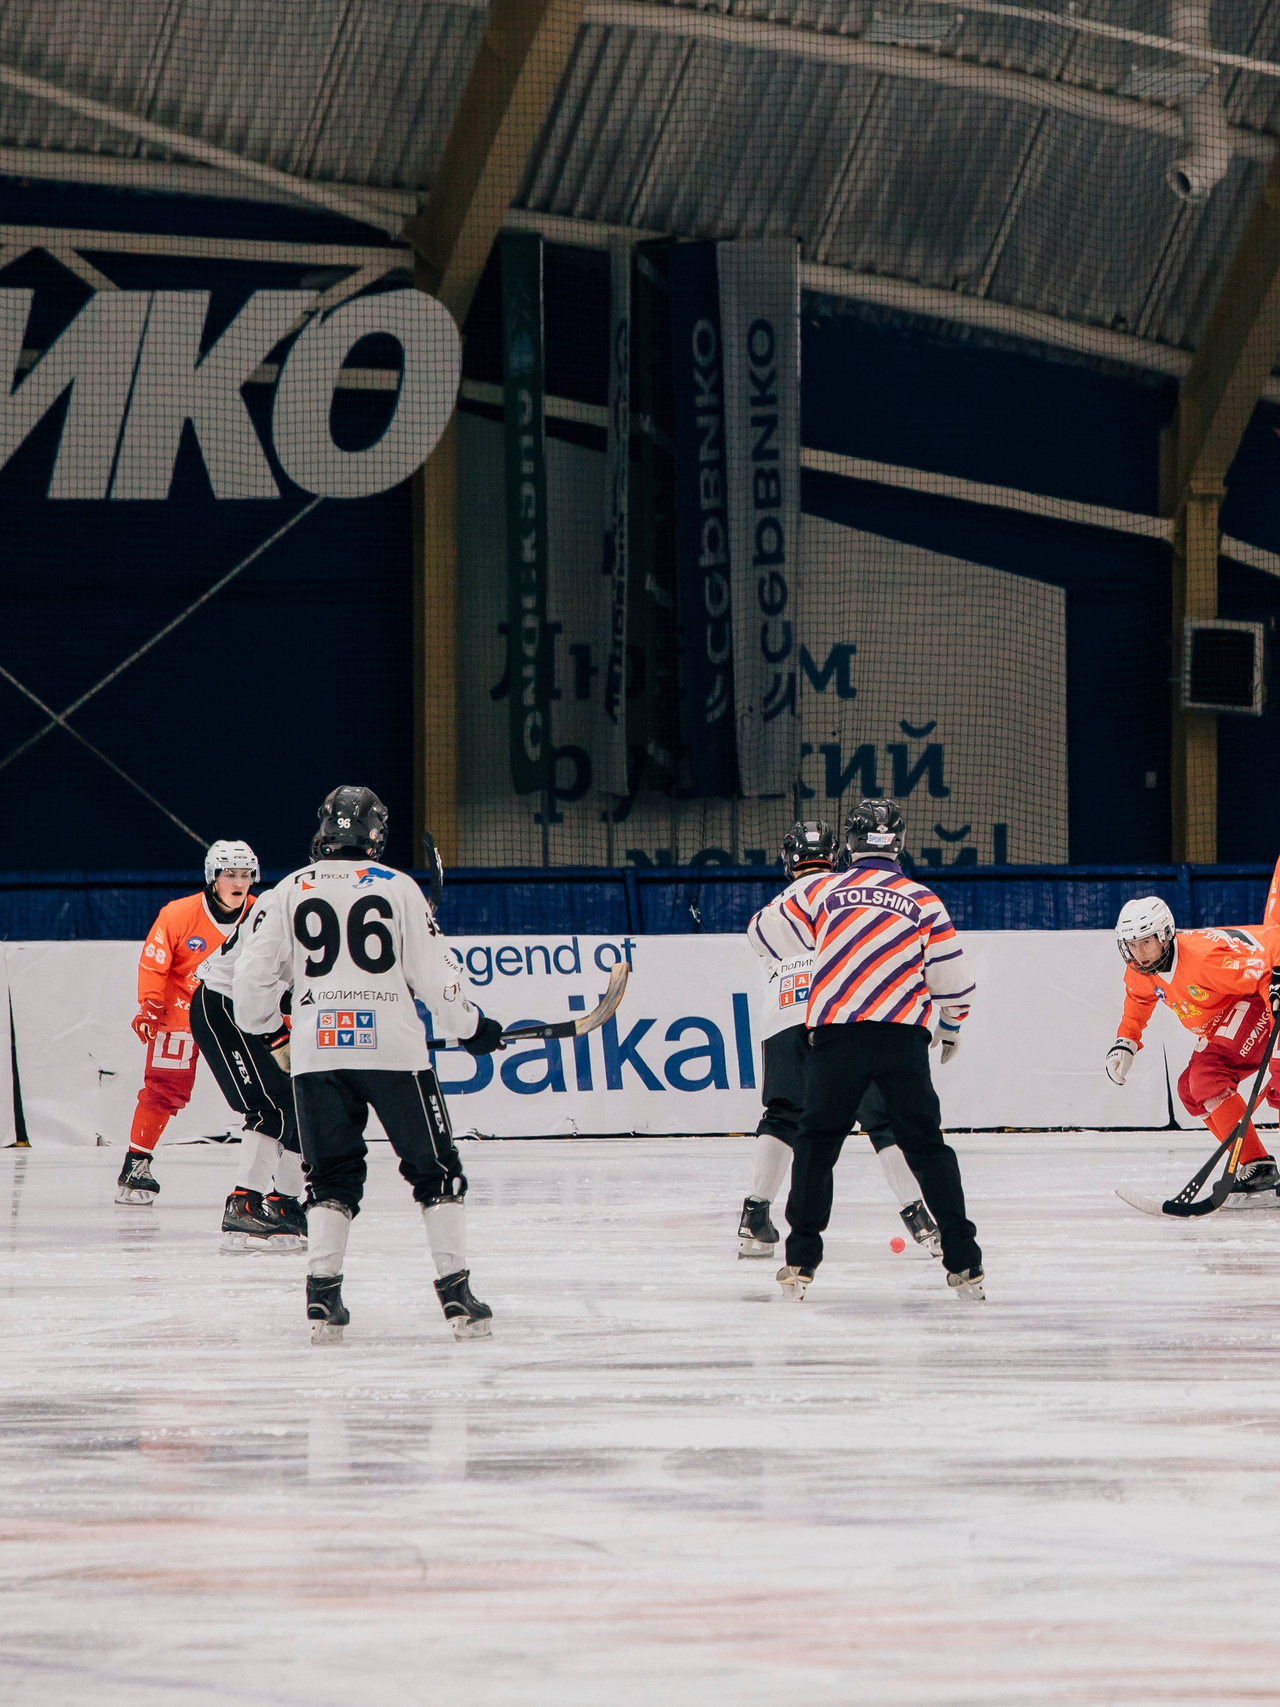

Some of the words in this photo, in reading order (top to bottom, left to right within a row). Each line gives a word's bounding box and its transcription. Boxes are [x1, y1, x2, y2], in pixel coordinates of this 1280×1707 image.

[337, 818, 351, 829] 96
[835, 888, 915, 915] TOLSHIN
[294, 894, 396, 978] 96
[594, 937, 637, 973] of
[317, 990, 399, 1002] ПОЛИМЕТАЛЛ
